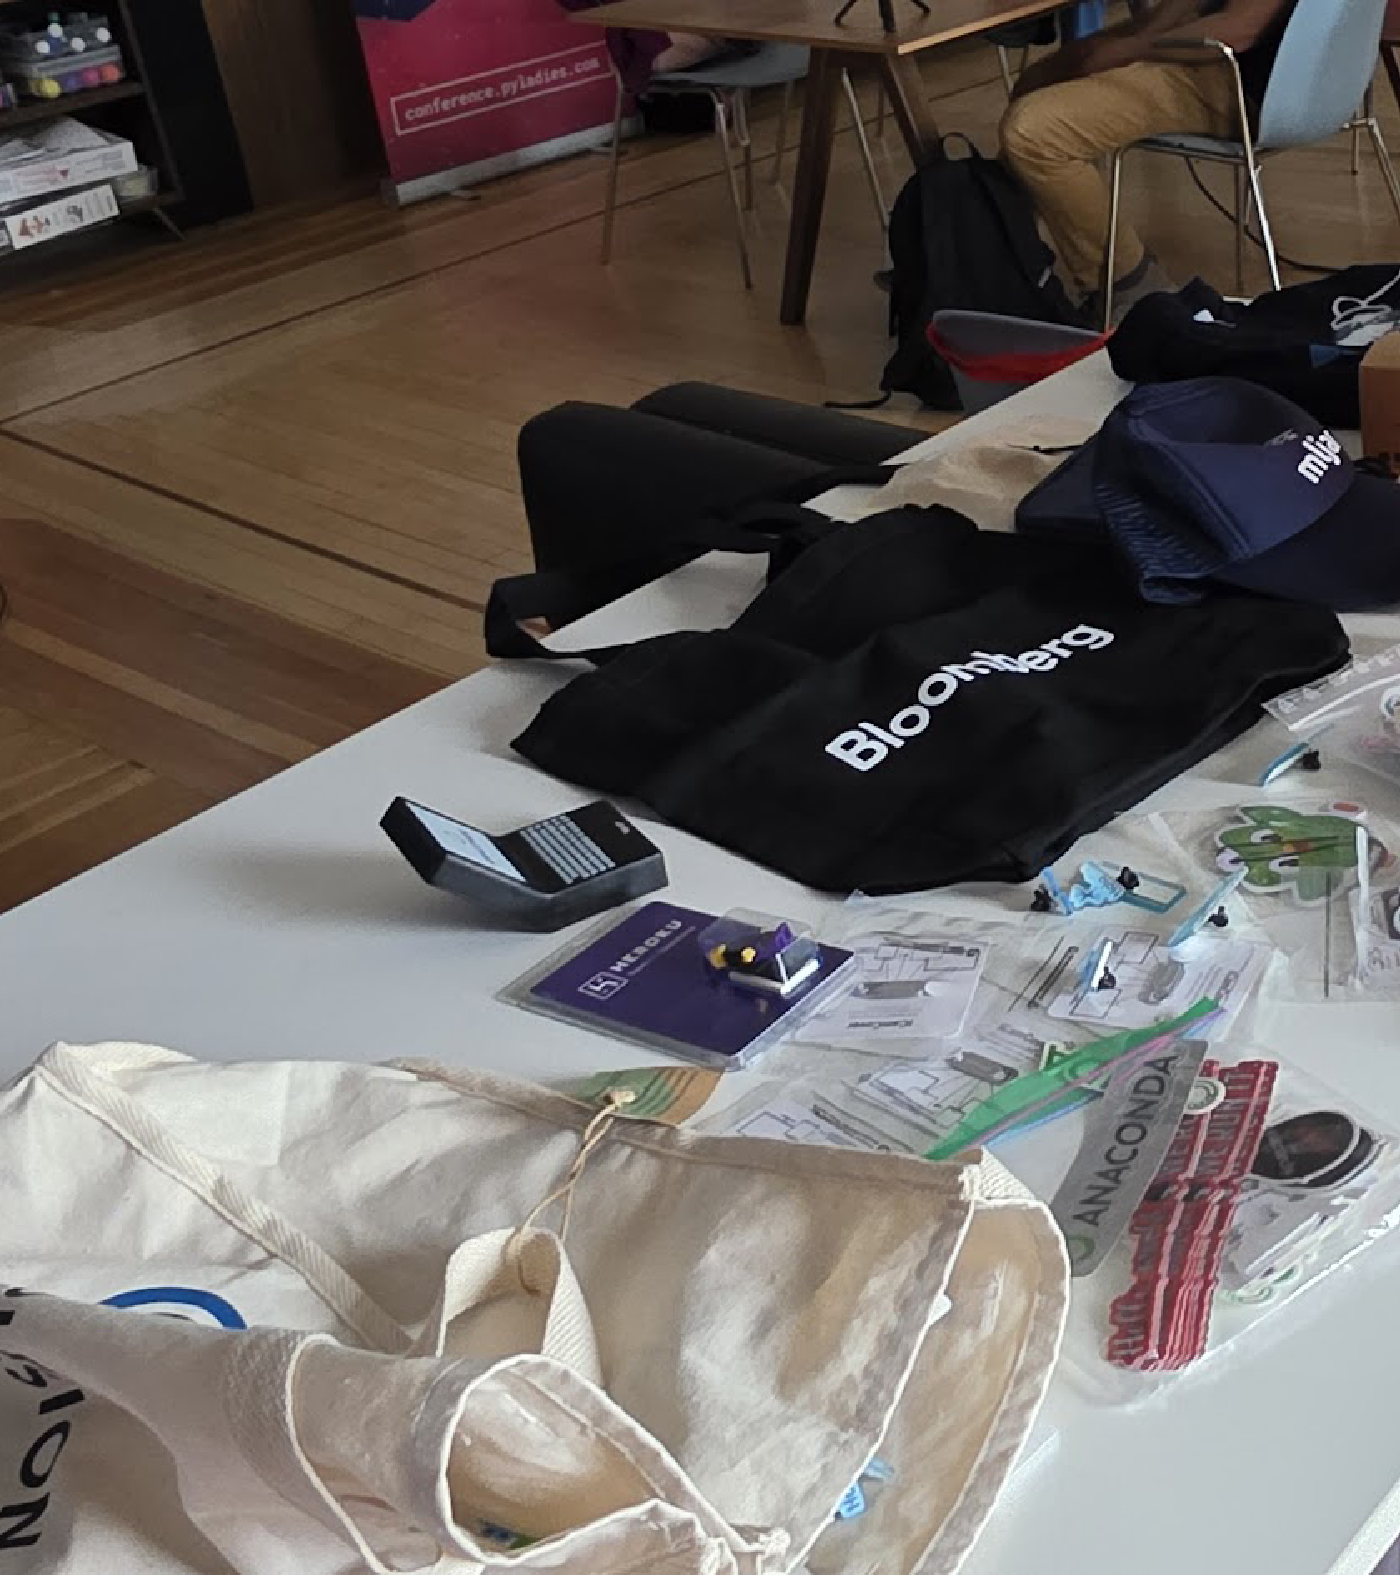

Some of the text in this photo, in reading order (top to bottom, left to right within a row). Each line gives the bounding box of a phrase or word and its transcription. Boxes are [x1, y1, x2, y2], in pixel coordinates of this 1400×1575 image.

[404, 57, 599, 121] conference.pyladies.com
[609, 919, 682, 972] HEROKU
[1072, 1055, 1179, 1226] ANACONDA
